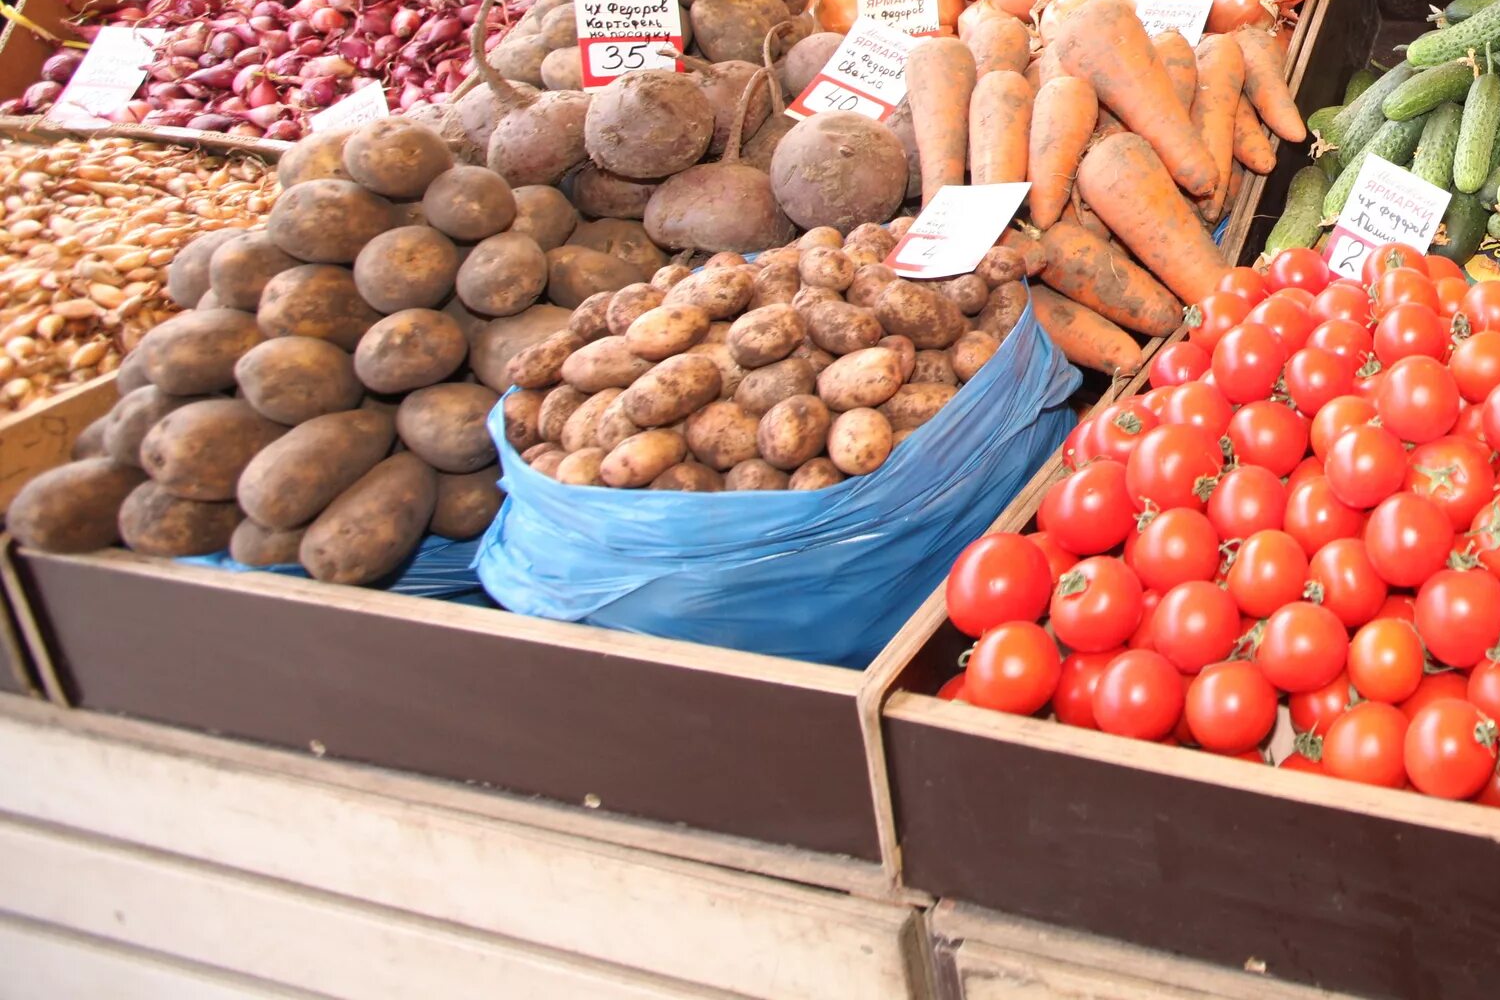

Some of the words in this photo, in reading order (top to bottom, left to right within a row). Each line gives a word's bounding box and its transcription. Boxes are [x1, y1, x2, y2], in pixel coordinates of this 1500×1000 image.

[586, 17, 663, 32] Картофель
[602, 45, 648, 70] 35
[853, 36, 909, 65] ЯРМАРК
[838, 60, 884, 90] Свекла
[824, 87, 858, 111] 40
[1365, 180, 1435, 222] ЯРМАРКИ
